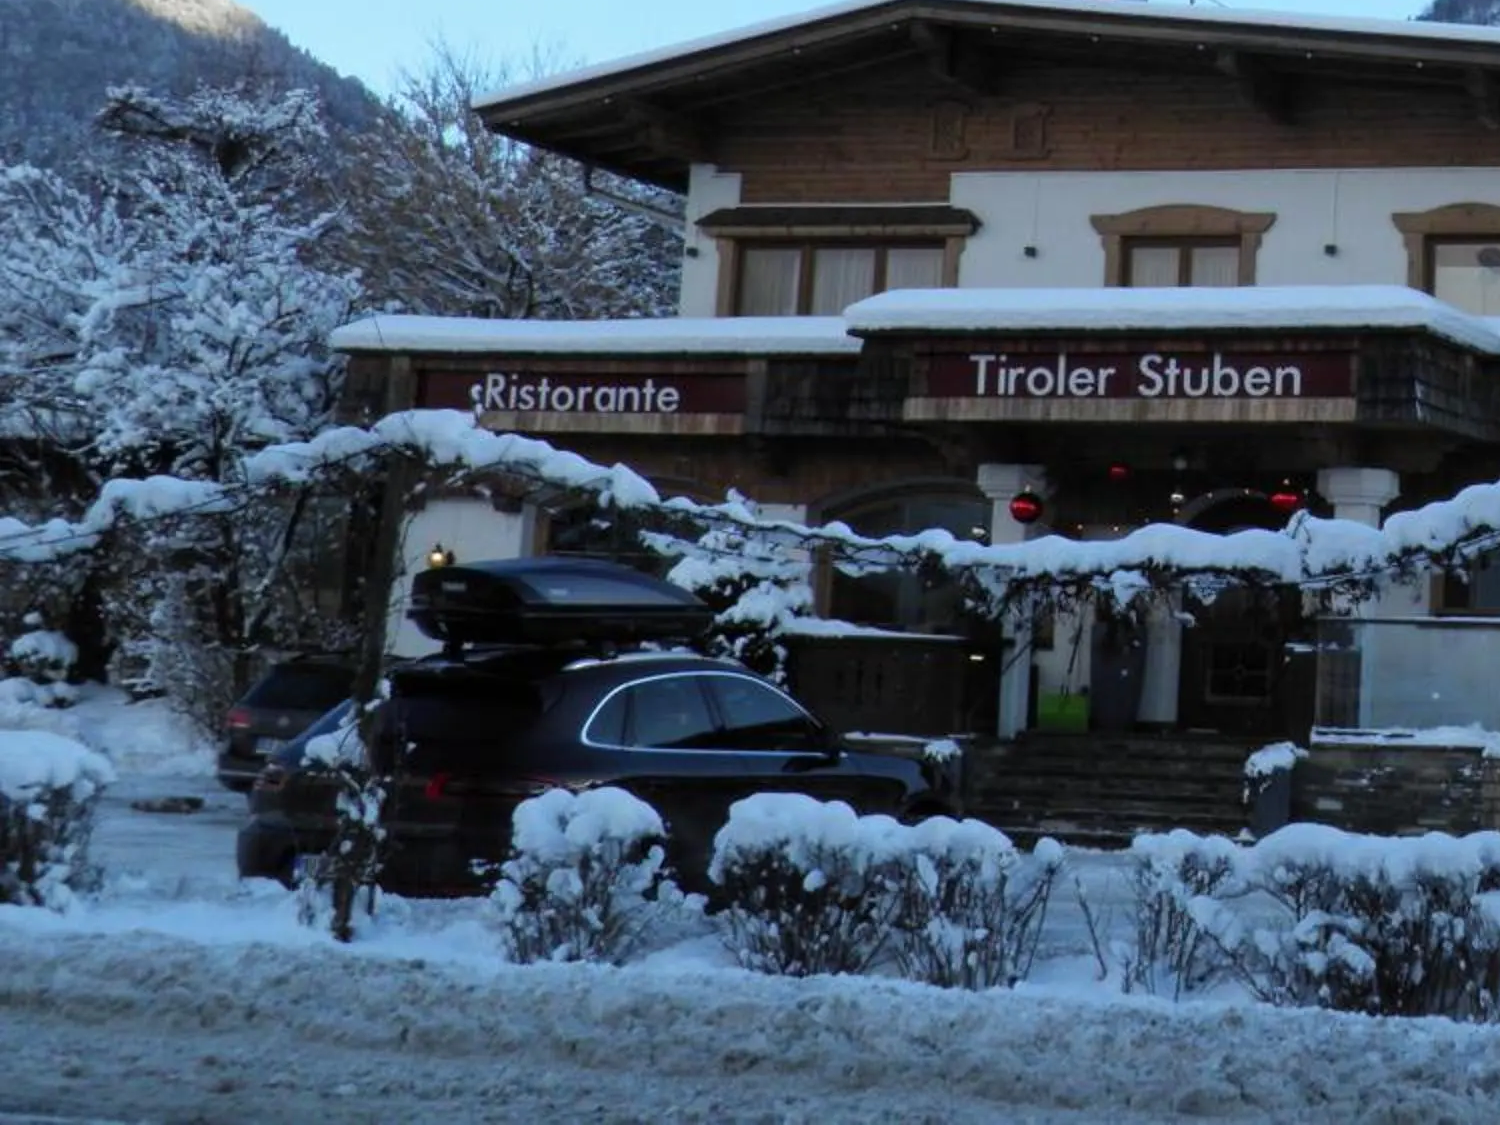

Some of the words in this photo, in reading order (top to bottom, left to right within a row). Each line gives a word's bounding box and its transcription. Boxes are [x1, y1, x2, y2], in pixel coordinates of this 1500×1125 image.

[484, 373, 681, 413] Ristorante
[969, 353, 1116, 397] Tiroler
[1137, 353, 1302, 397] Stuben
